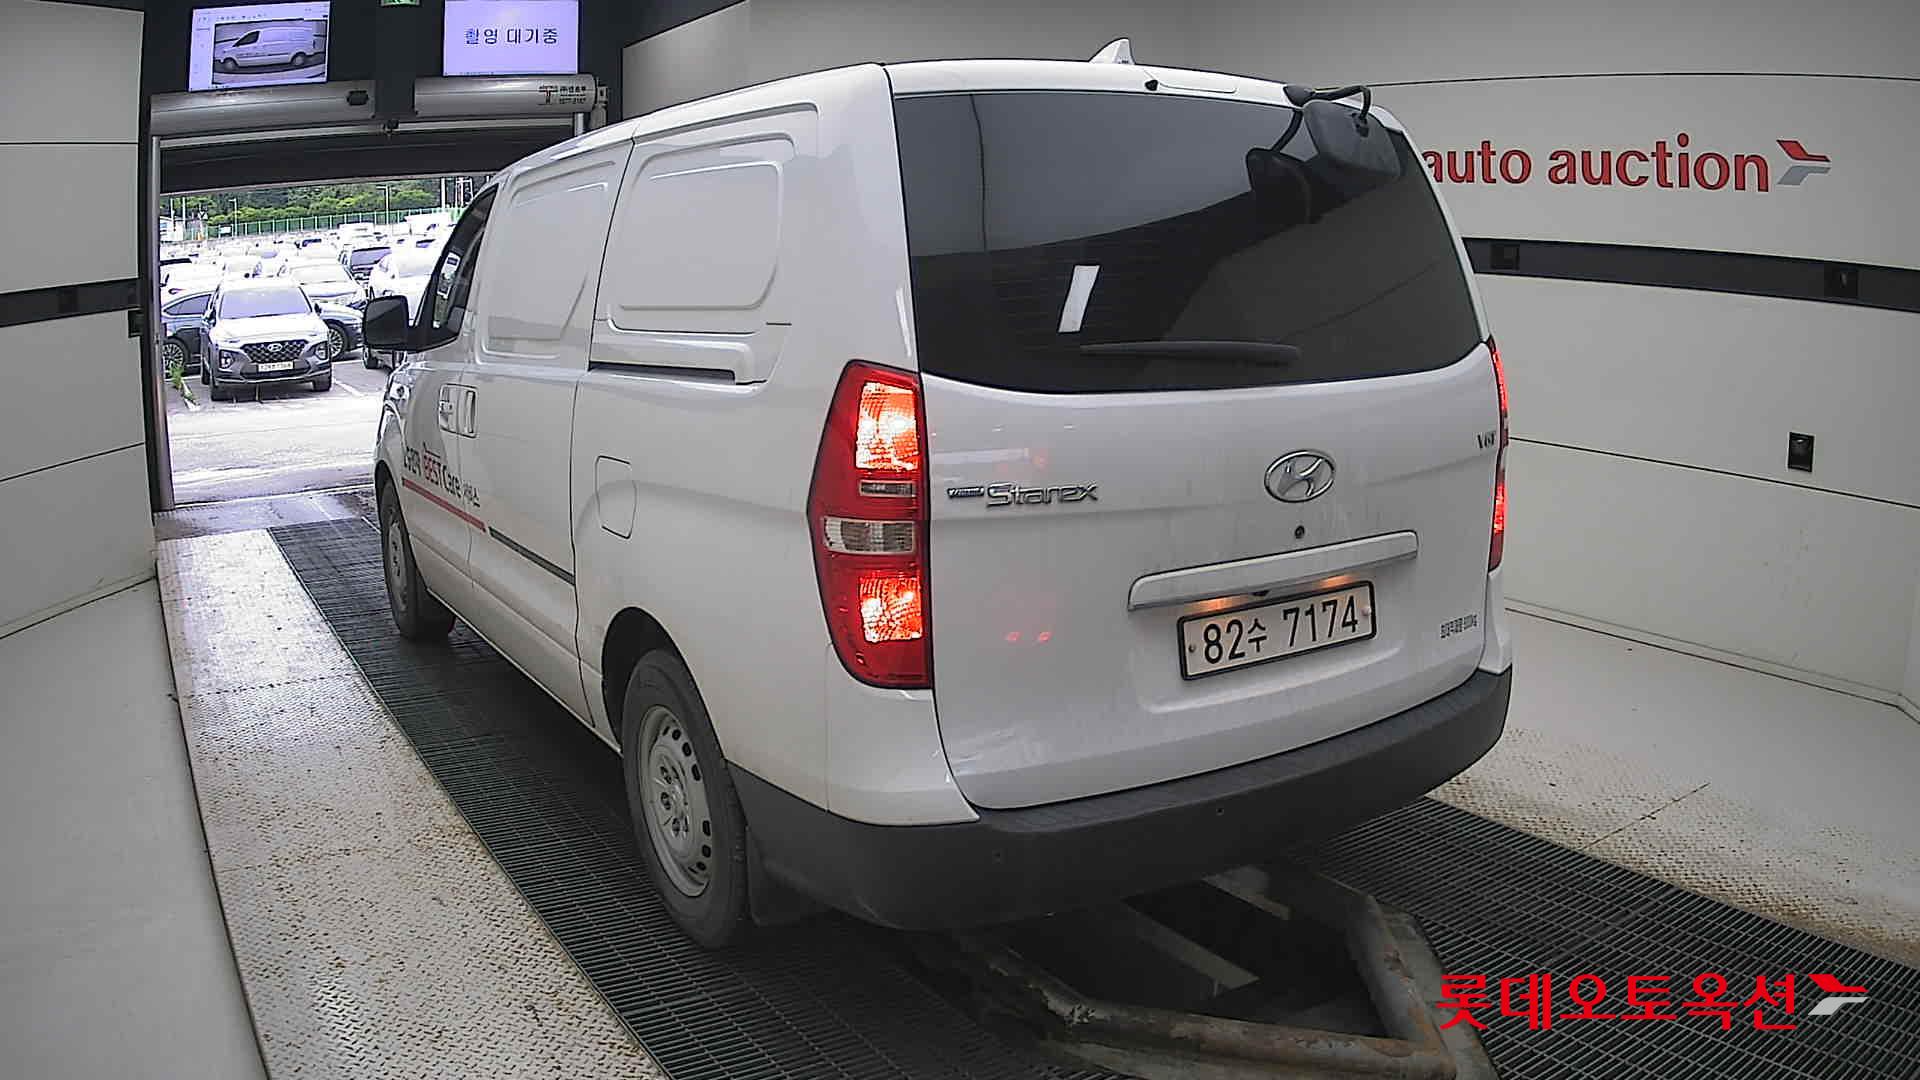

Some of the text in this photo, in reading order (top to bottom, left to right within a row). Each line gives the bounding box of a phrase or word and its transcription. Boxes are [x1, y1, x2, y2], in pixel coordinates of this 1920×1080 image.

[507, 28, 558, 45] 대기중
[1422, 132, 1770, 193] auto auction
[986, 482, 1098, 508] Starex
[1203, 595, 1359, 665] 82수 7174
